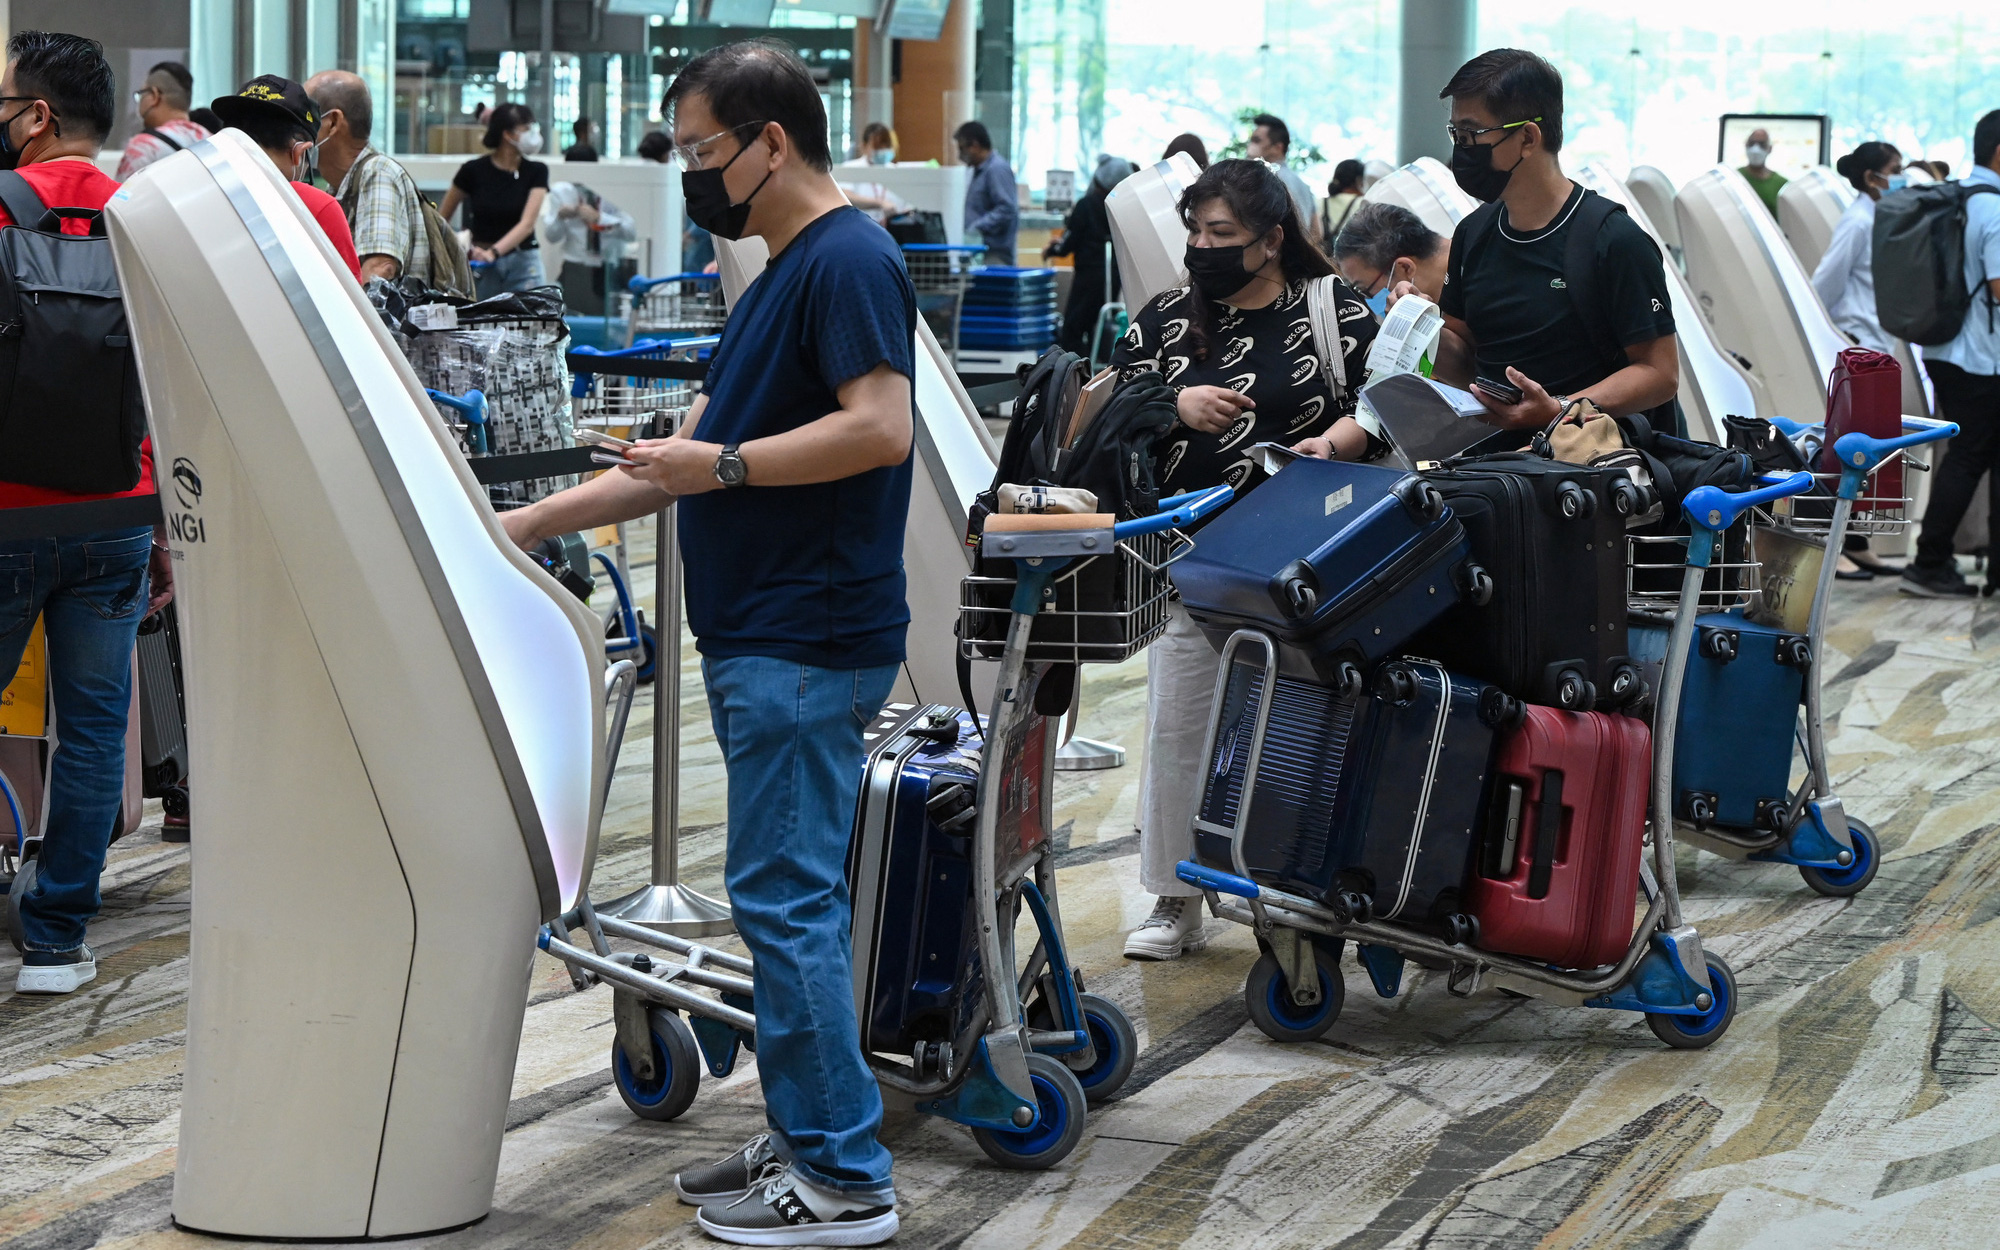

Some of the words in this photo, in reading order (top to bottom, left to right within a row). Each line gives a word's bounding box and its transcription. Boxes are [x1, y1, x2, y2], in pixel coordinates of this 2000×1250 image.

[1283, 324, 1308, 346] JKFS.COM
[1291, 361, 1312, 380] JKFS.COM
[1289, 404, 1318, 427] JKFS.COM
[1219, 421, 1247, 445] JKFS.COM
[168, 512, 206, 543] NGI
